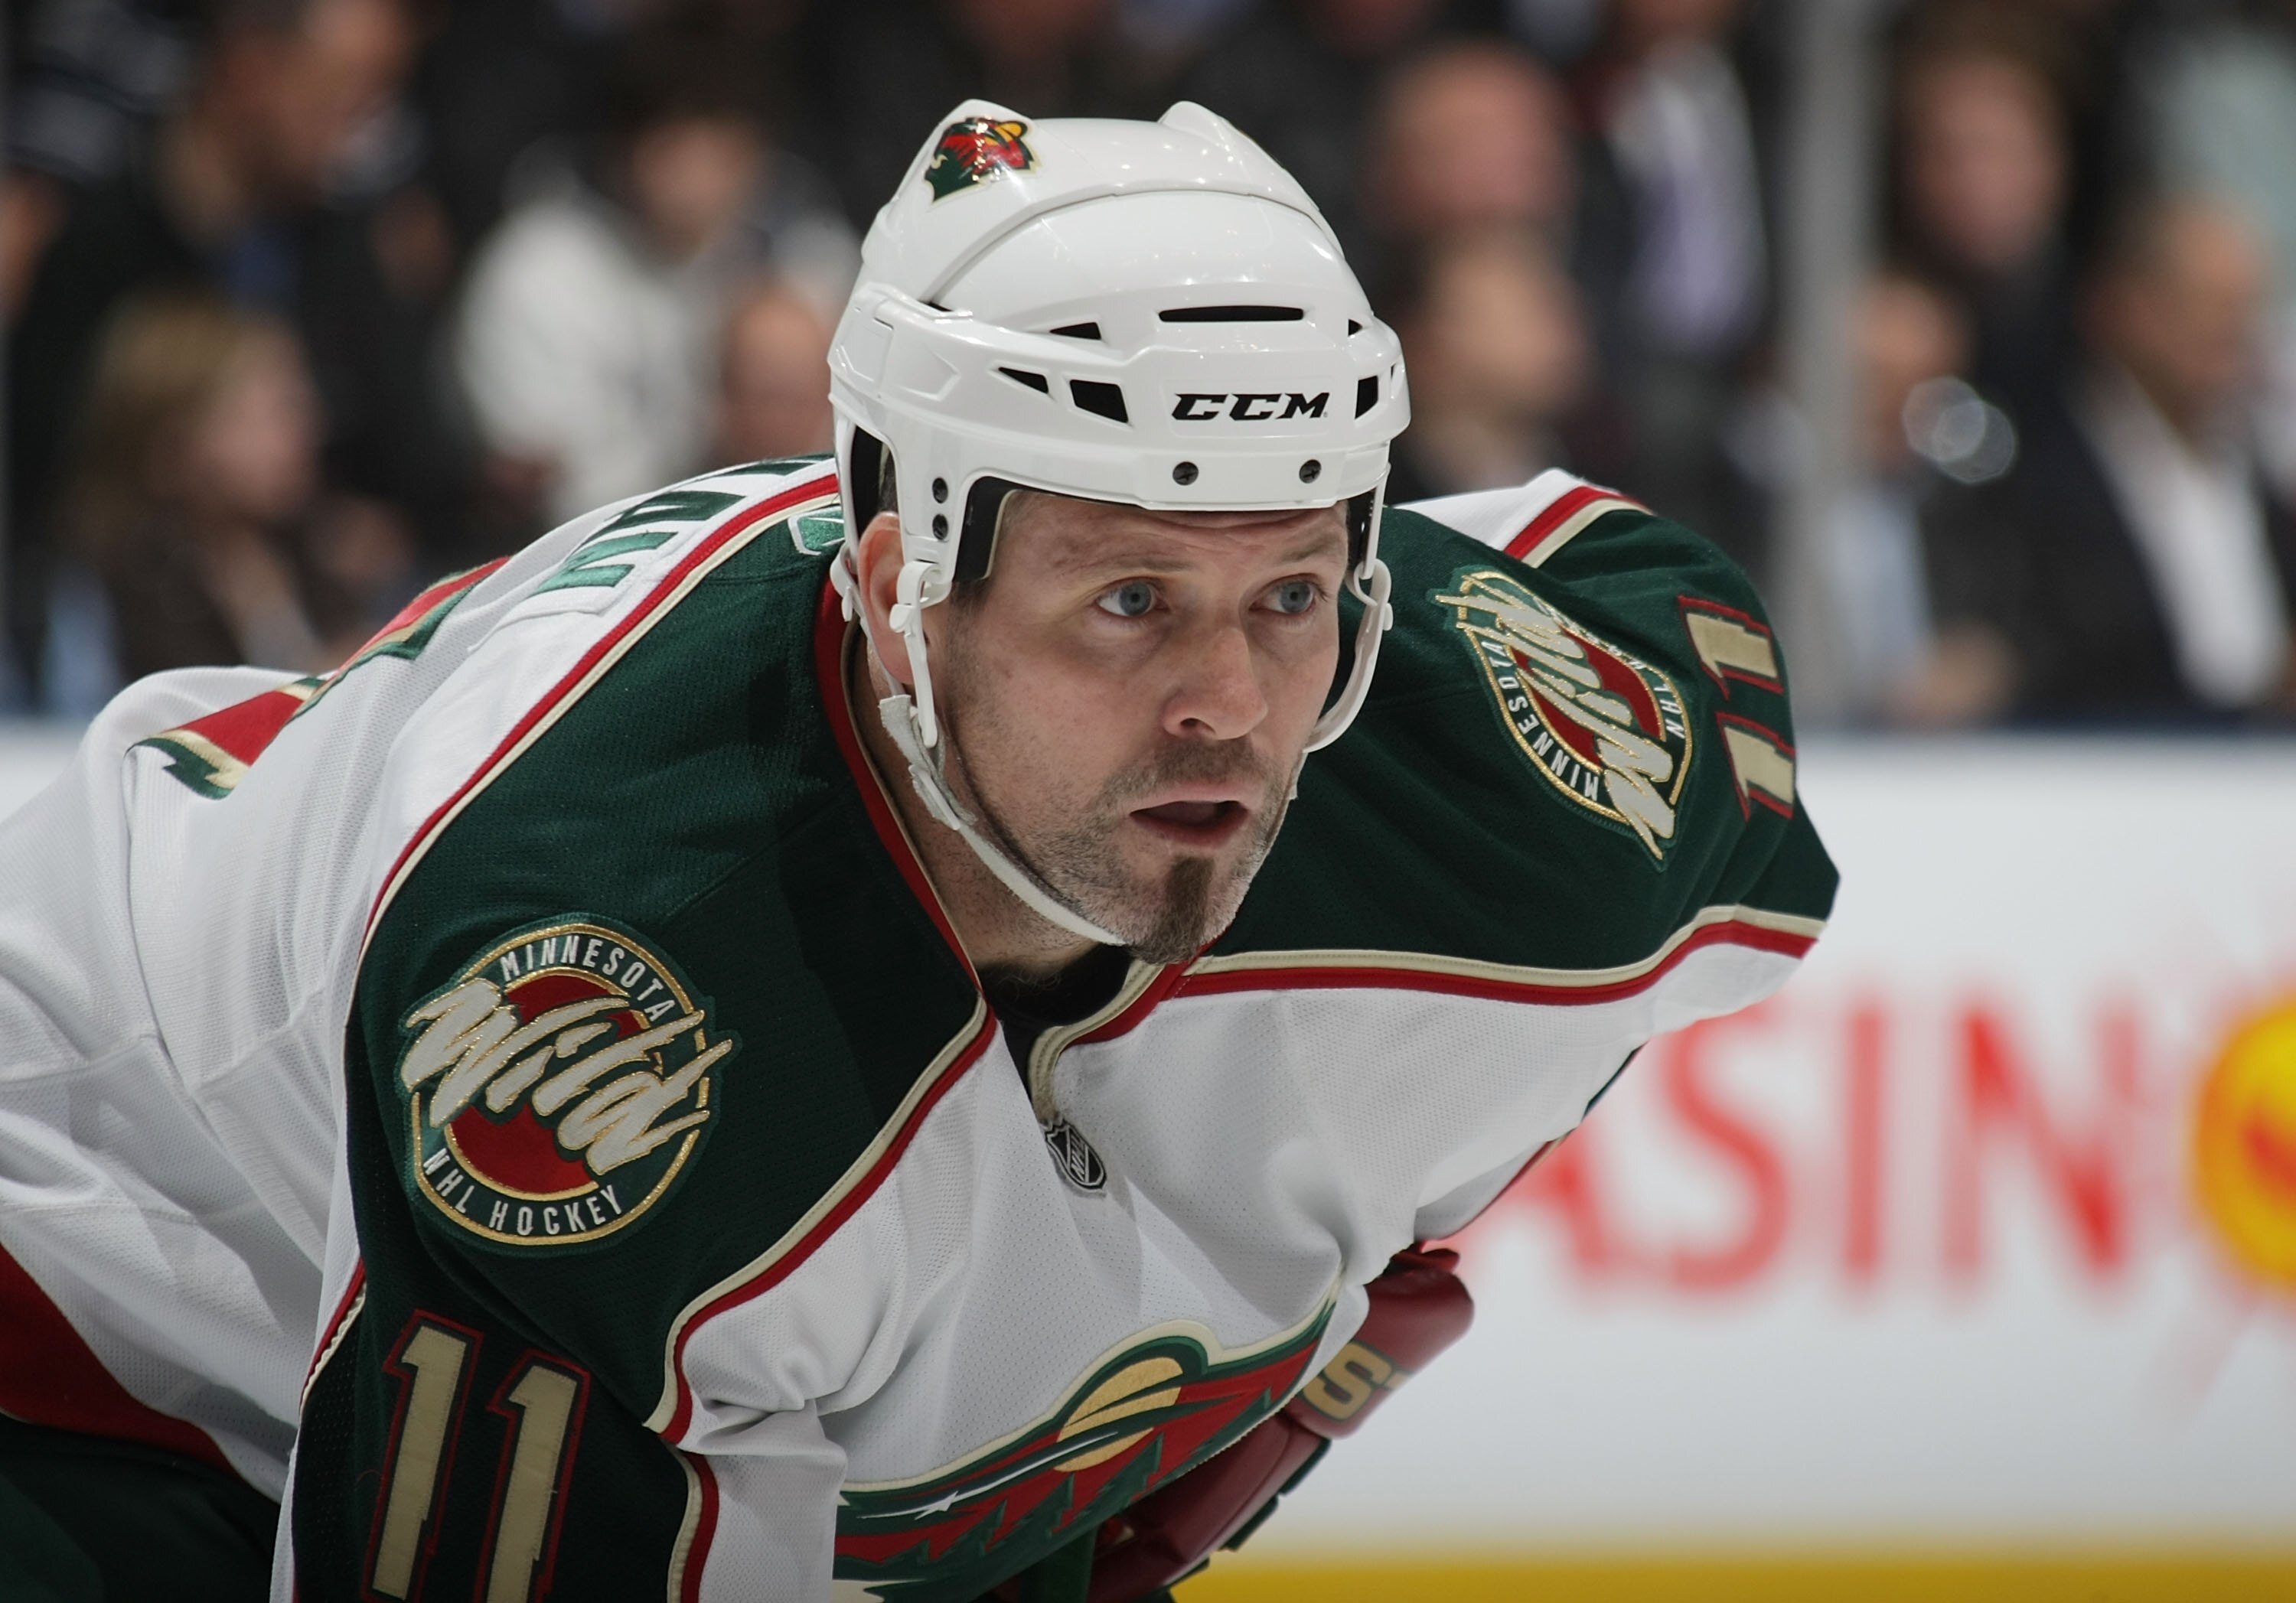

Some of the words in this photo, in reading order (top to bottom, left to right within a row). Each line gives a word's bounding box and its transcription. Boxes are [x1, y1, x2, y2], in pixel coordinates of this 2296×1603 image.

[1172, 392, 1330, 422] CCM
[1480, 639, 1600, 803] MINNESOTA
[1678, 595, 1797, 823] 11
[499, 934, 677, 1022] MINNESOTA
[400, 976, 733, 1177] Wild
[422, 1147, 477, 1214] NHL
[488, 1184, 624, 1236] HOCKEY
[360, 1308, 592, 1603] 11
